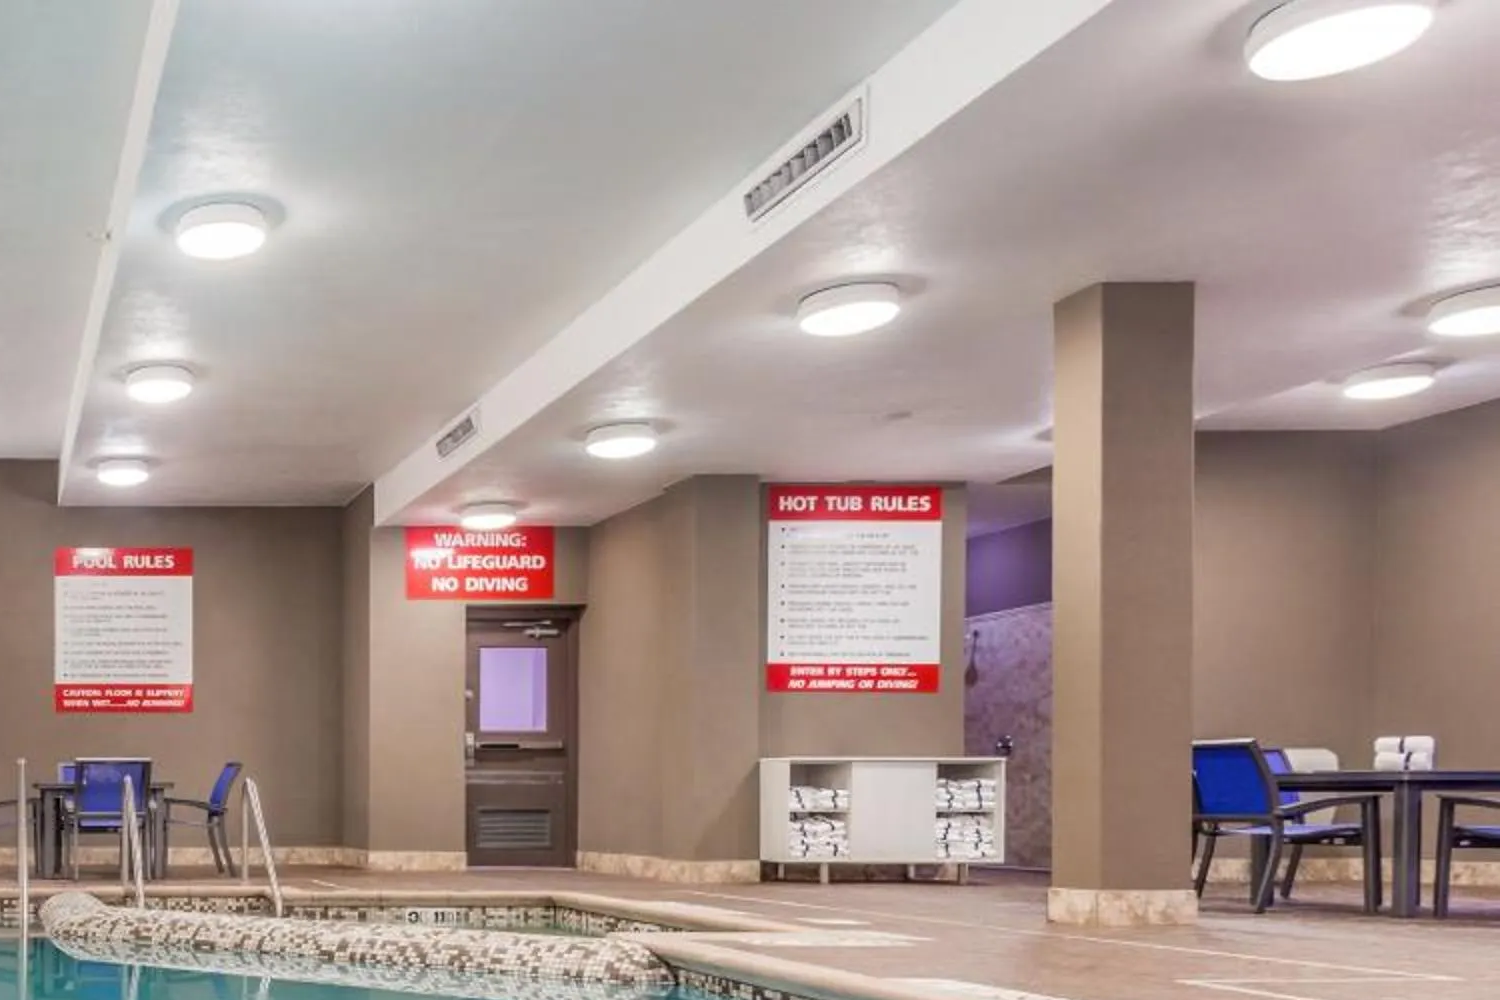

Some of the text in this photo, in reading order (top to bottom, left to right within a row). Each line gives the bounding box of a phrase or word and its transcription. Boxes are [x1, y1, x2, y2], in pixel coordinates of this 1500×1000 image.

[779, 495, 931, 512] HOT TUB RULES
[434, 532, 528, 547] WARNING:
[72, 554, 176, 569] POOL RULES
[413, 554, 546, 570] NO LIFEGUARD
[431, 577, 528, 592] NO DIVING
[828, 666, 842, 677] BY
[846, 666, 878, 677] STEPS
[788, 679, 805, 689] NO
[809, 679, 855, 690] JUMPING
[858, 679, 874, 689] OR
